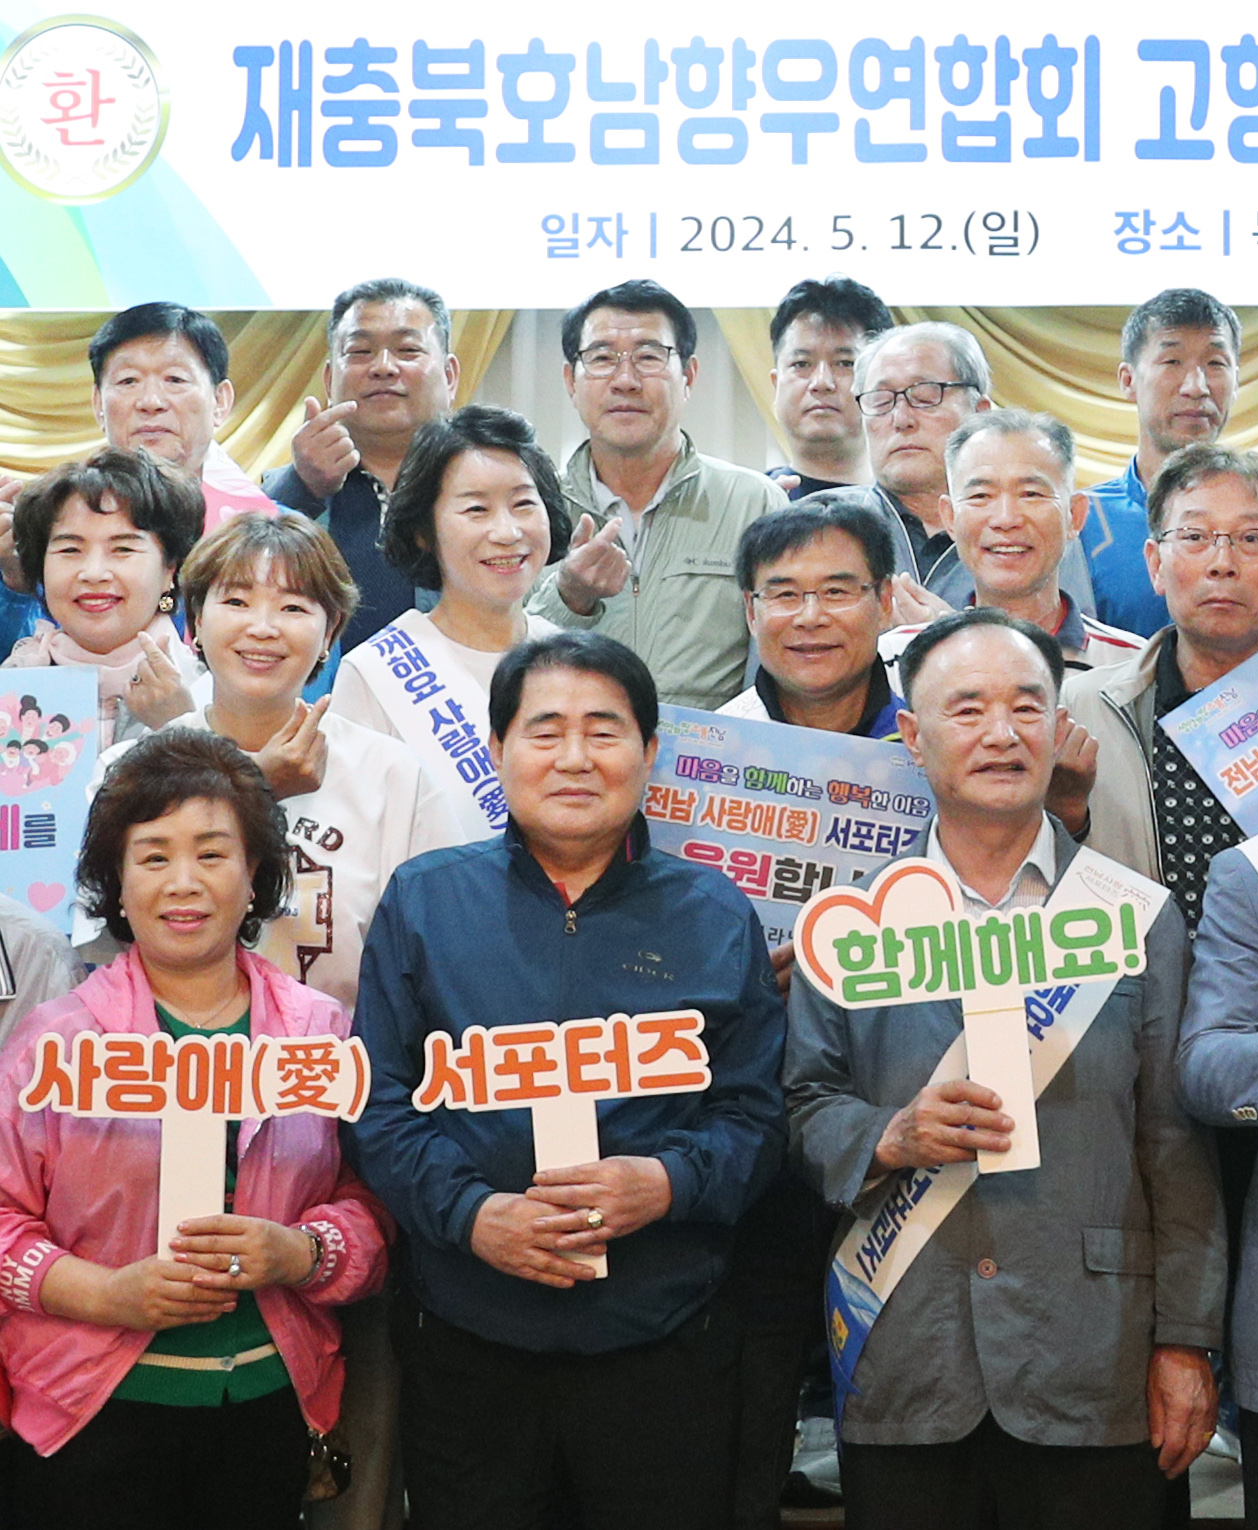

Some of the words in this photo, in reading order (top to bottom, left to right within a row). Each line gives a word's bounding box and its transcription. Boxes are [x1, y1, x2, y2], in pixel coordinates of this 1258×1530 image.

[41, 66, 116, 147] 환
[231, 34, 1101, 168] 재충북호남향우연합회
[541, 212, 629, 258] 일자
[680, 215, 808, 251] 2024.
[831, 215, 868, 251] 5.
[1113, 209, 1202, 255] 장소
[644, 784, 698, 822] 전남
[700, 795, 818, 843] 사랑애(愛)
[675, 754, 740, 787] 마음을
[744, 765, 823, 799] 함께하는
[827, 780, 891, 811] 행복한
[893, 796, 931, 818] 이음
[832, 902, 1140, 1003] 함께해요!
[26, 1038, 365, 1117] 사랑애(愛)
[419, 1016, 706, 1106] 서포터즈
